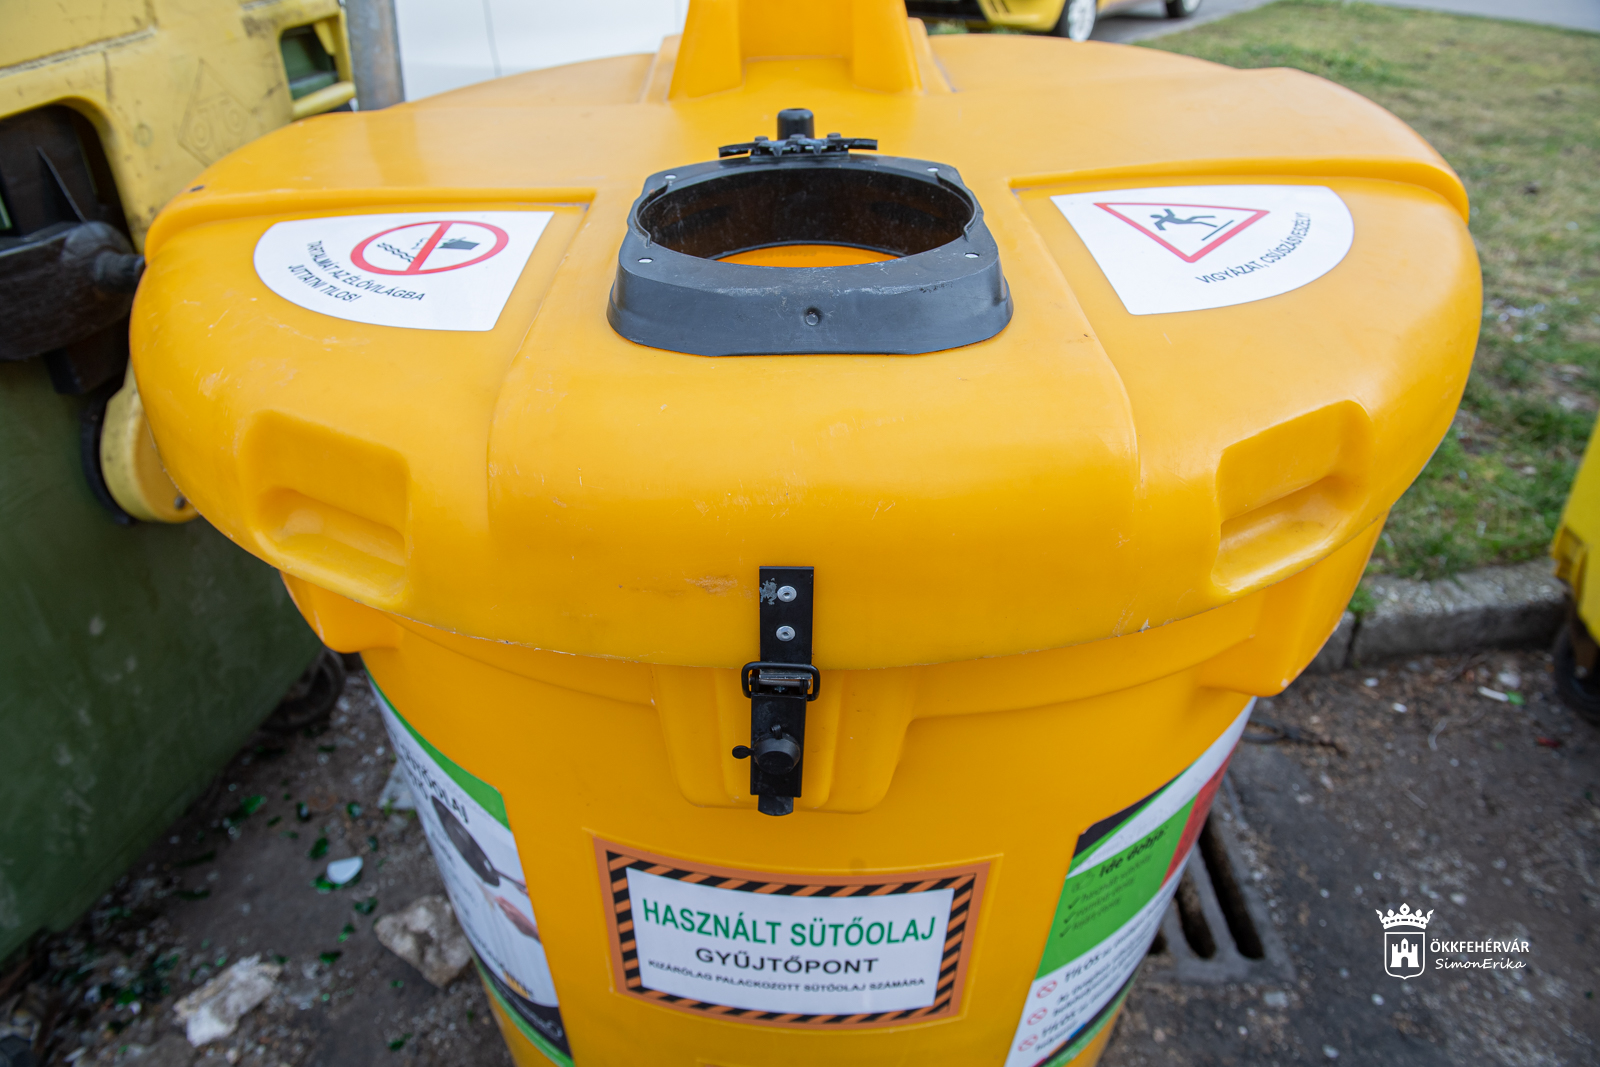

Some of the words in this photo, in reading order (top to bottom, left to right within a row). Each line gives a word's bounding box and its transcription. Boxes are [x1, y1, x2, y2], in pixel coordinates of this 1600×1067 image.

[288, 263, 327, 289] JUTTATNI
[319, 284, 362, 303] TILOS!
[328, 270, 351, 280] AZ
[1195, 260, 1270, 284] VIGYÁZAT,
[642, 898, 782, 945] HASZNÁLT
[790, 916, 936, 947] SÜTŐOLAJ
[695, 947, 879, 975] GYŰJTŐPONT
[648, 960, 714, 981] KIZÁRÓLAG
[715, 976, 801, 992] PALACKOZOTT
[804, 982, 866, 993] SÜTŐOLAJ
[869, 977, 925, 991] SZÁMÁRA
